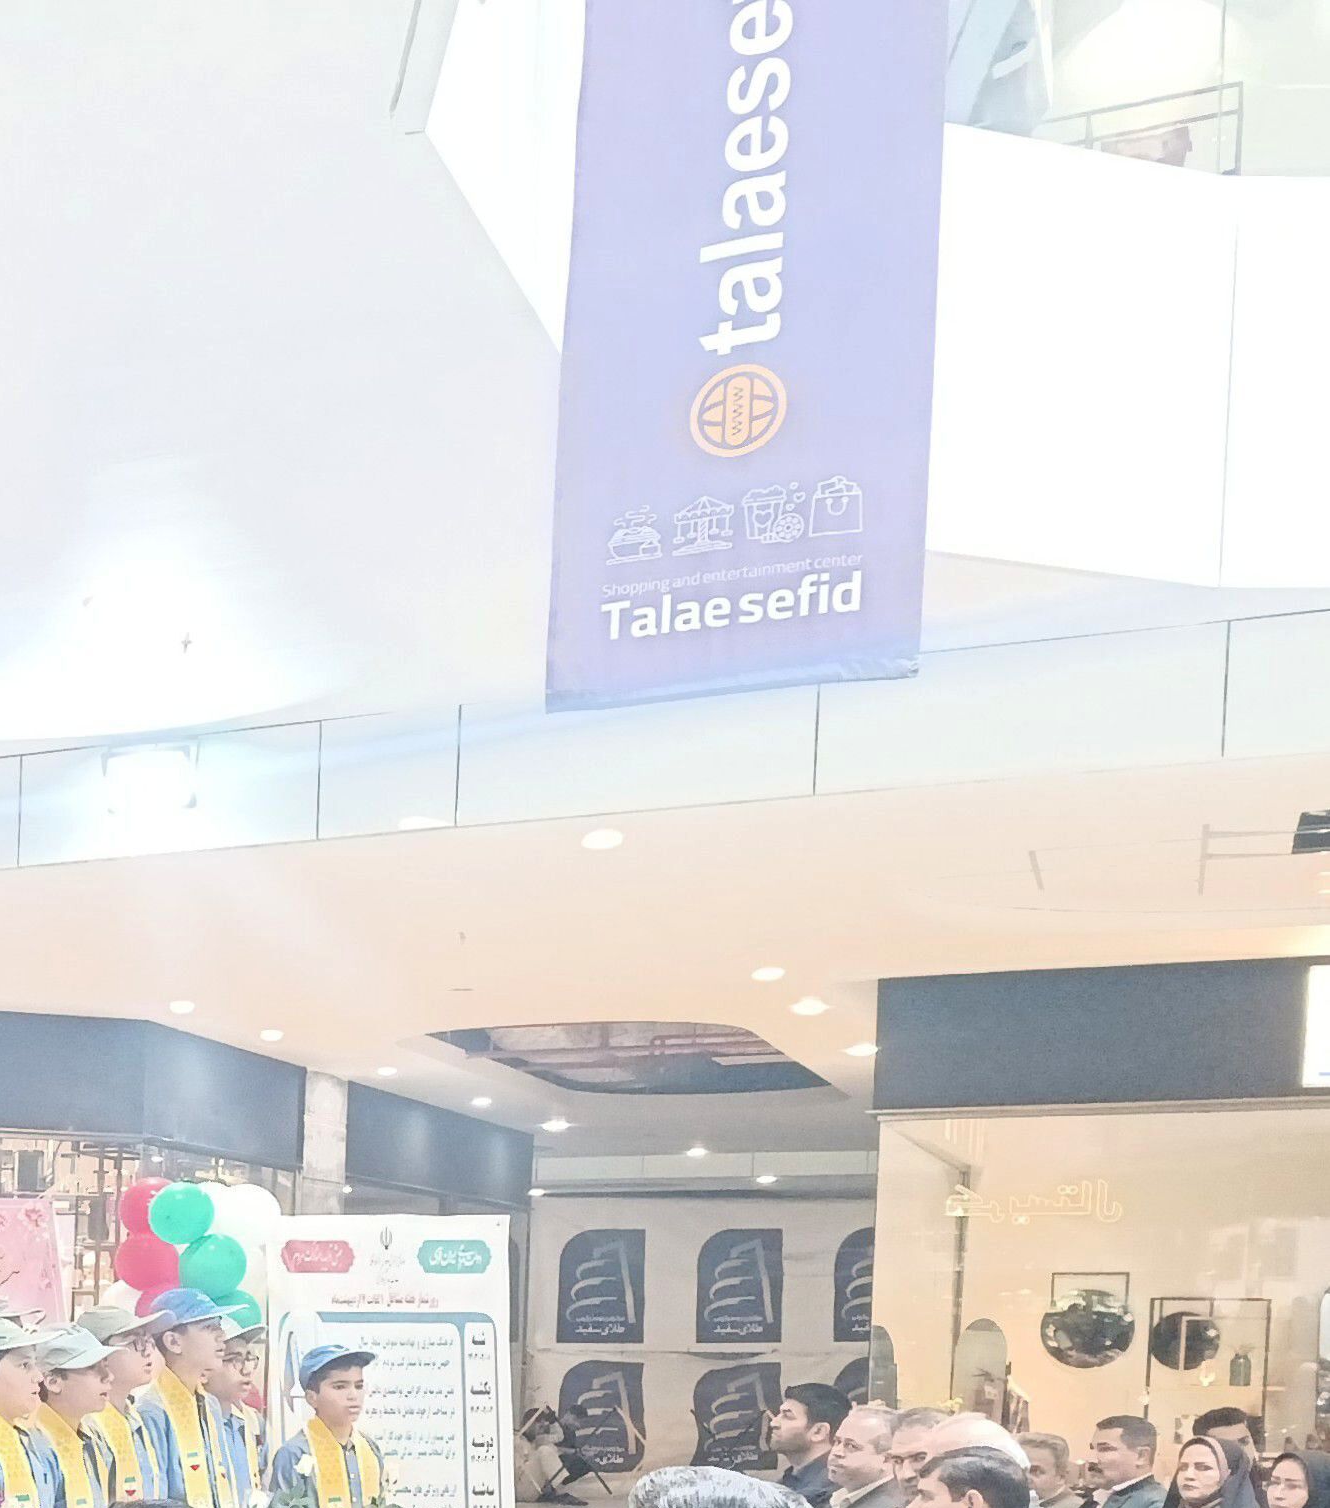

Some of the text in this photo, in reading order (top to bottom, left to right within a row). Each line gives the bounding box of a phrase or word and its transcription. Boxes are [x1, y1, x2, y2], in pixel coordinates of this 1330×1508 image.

[699, 0, 795, 356] talaese
[600, 570, 864, 641] Talae sefid
[601, 553, 863, 597] Shopping and entertainment center
